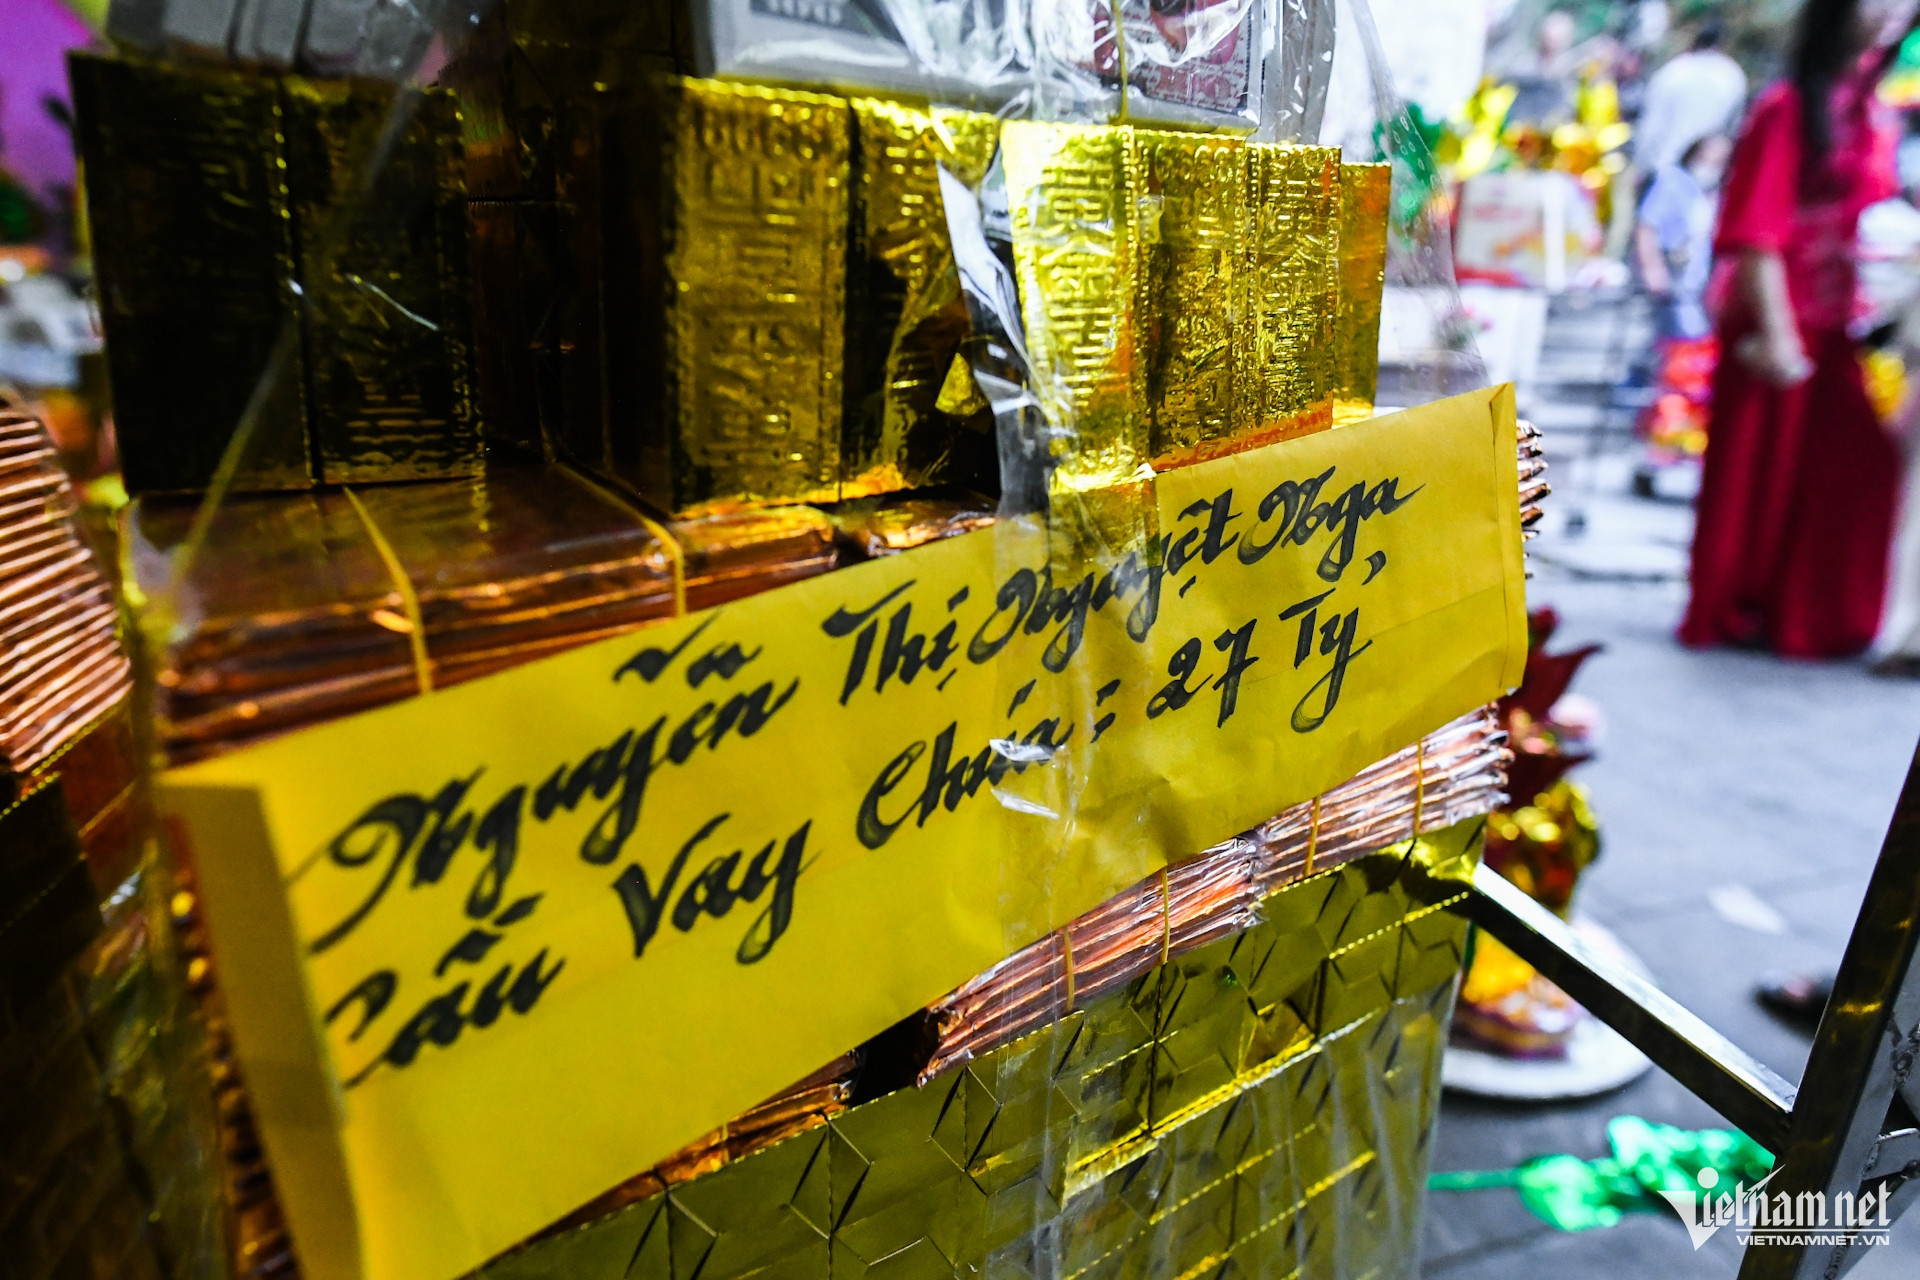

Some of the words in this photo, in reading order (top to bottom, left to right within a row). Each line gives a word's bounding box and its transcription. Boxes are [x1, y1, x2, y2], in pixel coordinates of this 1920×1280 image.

[289, 610, 800, 954] Nguyễn
[822, 578, 970, 706] Thị
[1237, 465, 1425, 582] Nga
[612, 812, 822, 964] Vay
[1147, 619, 1258, 728] 27
